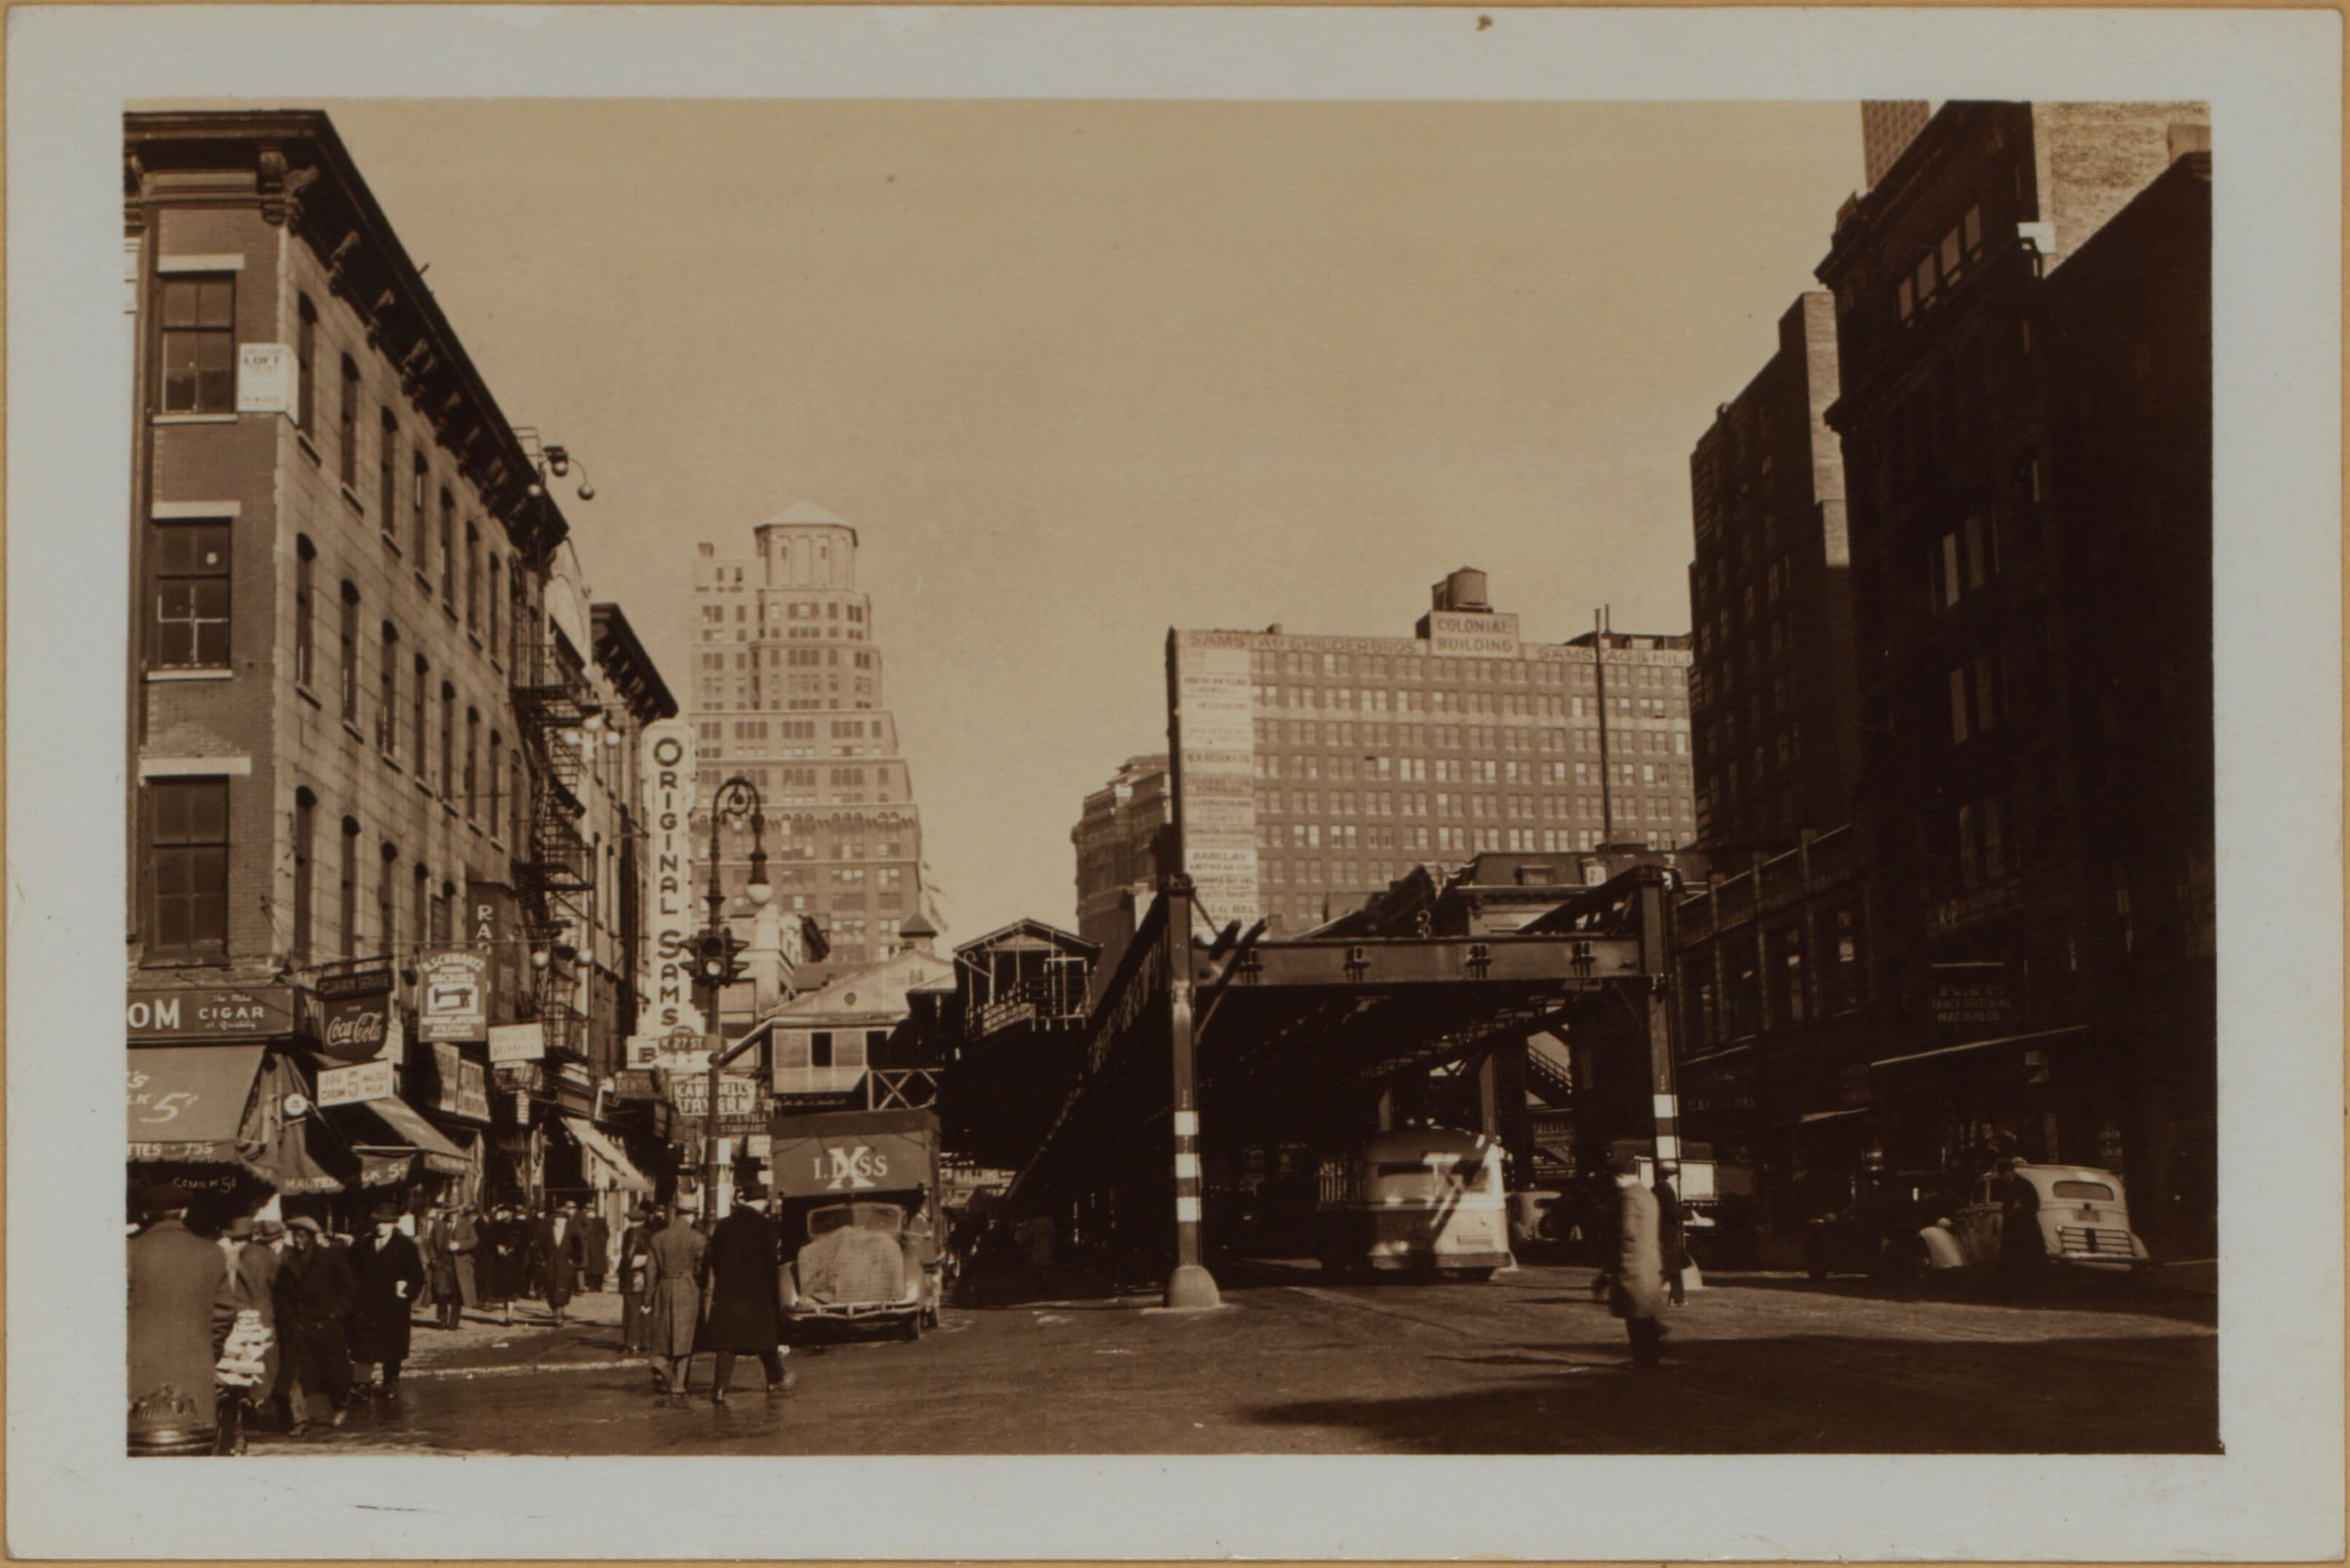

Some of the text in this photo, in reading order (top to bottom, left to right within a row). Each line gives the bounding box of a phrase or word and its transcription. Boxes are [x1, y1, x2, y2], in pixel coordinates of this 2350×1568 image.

[1437, 618, 1511, 634] COLONIAL
[1437, 637, 1514, 653] BUILDING
[1536, 648, 1632, 664] SAMSAG
[653, 737, 683, 915] ORIGINAL
[198, 1006, 265, 1020] CIGAR
[673, 1037, 688, 1048] 27
[689, 1037, 703, 1048] ST
[616, 1079, 652, 1091] DENTIS
